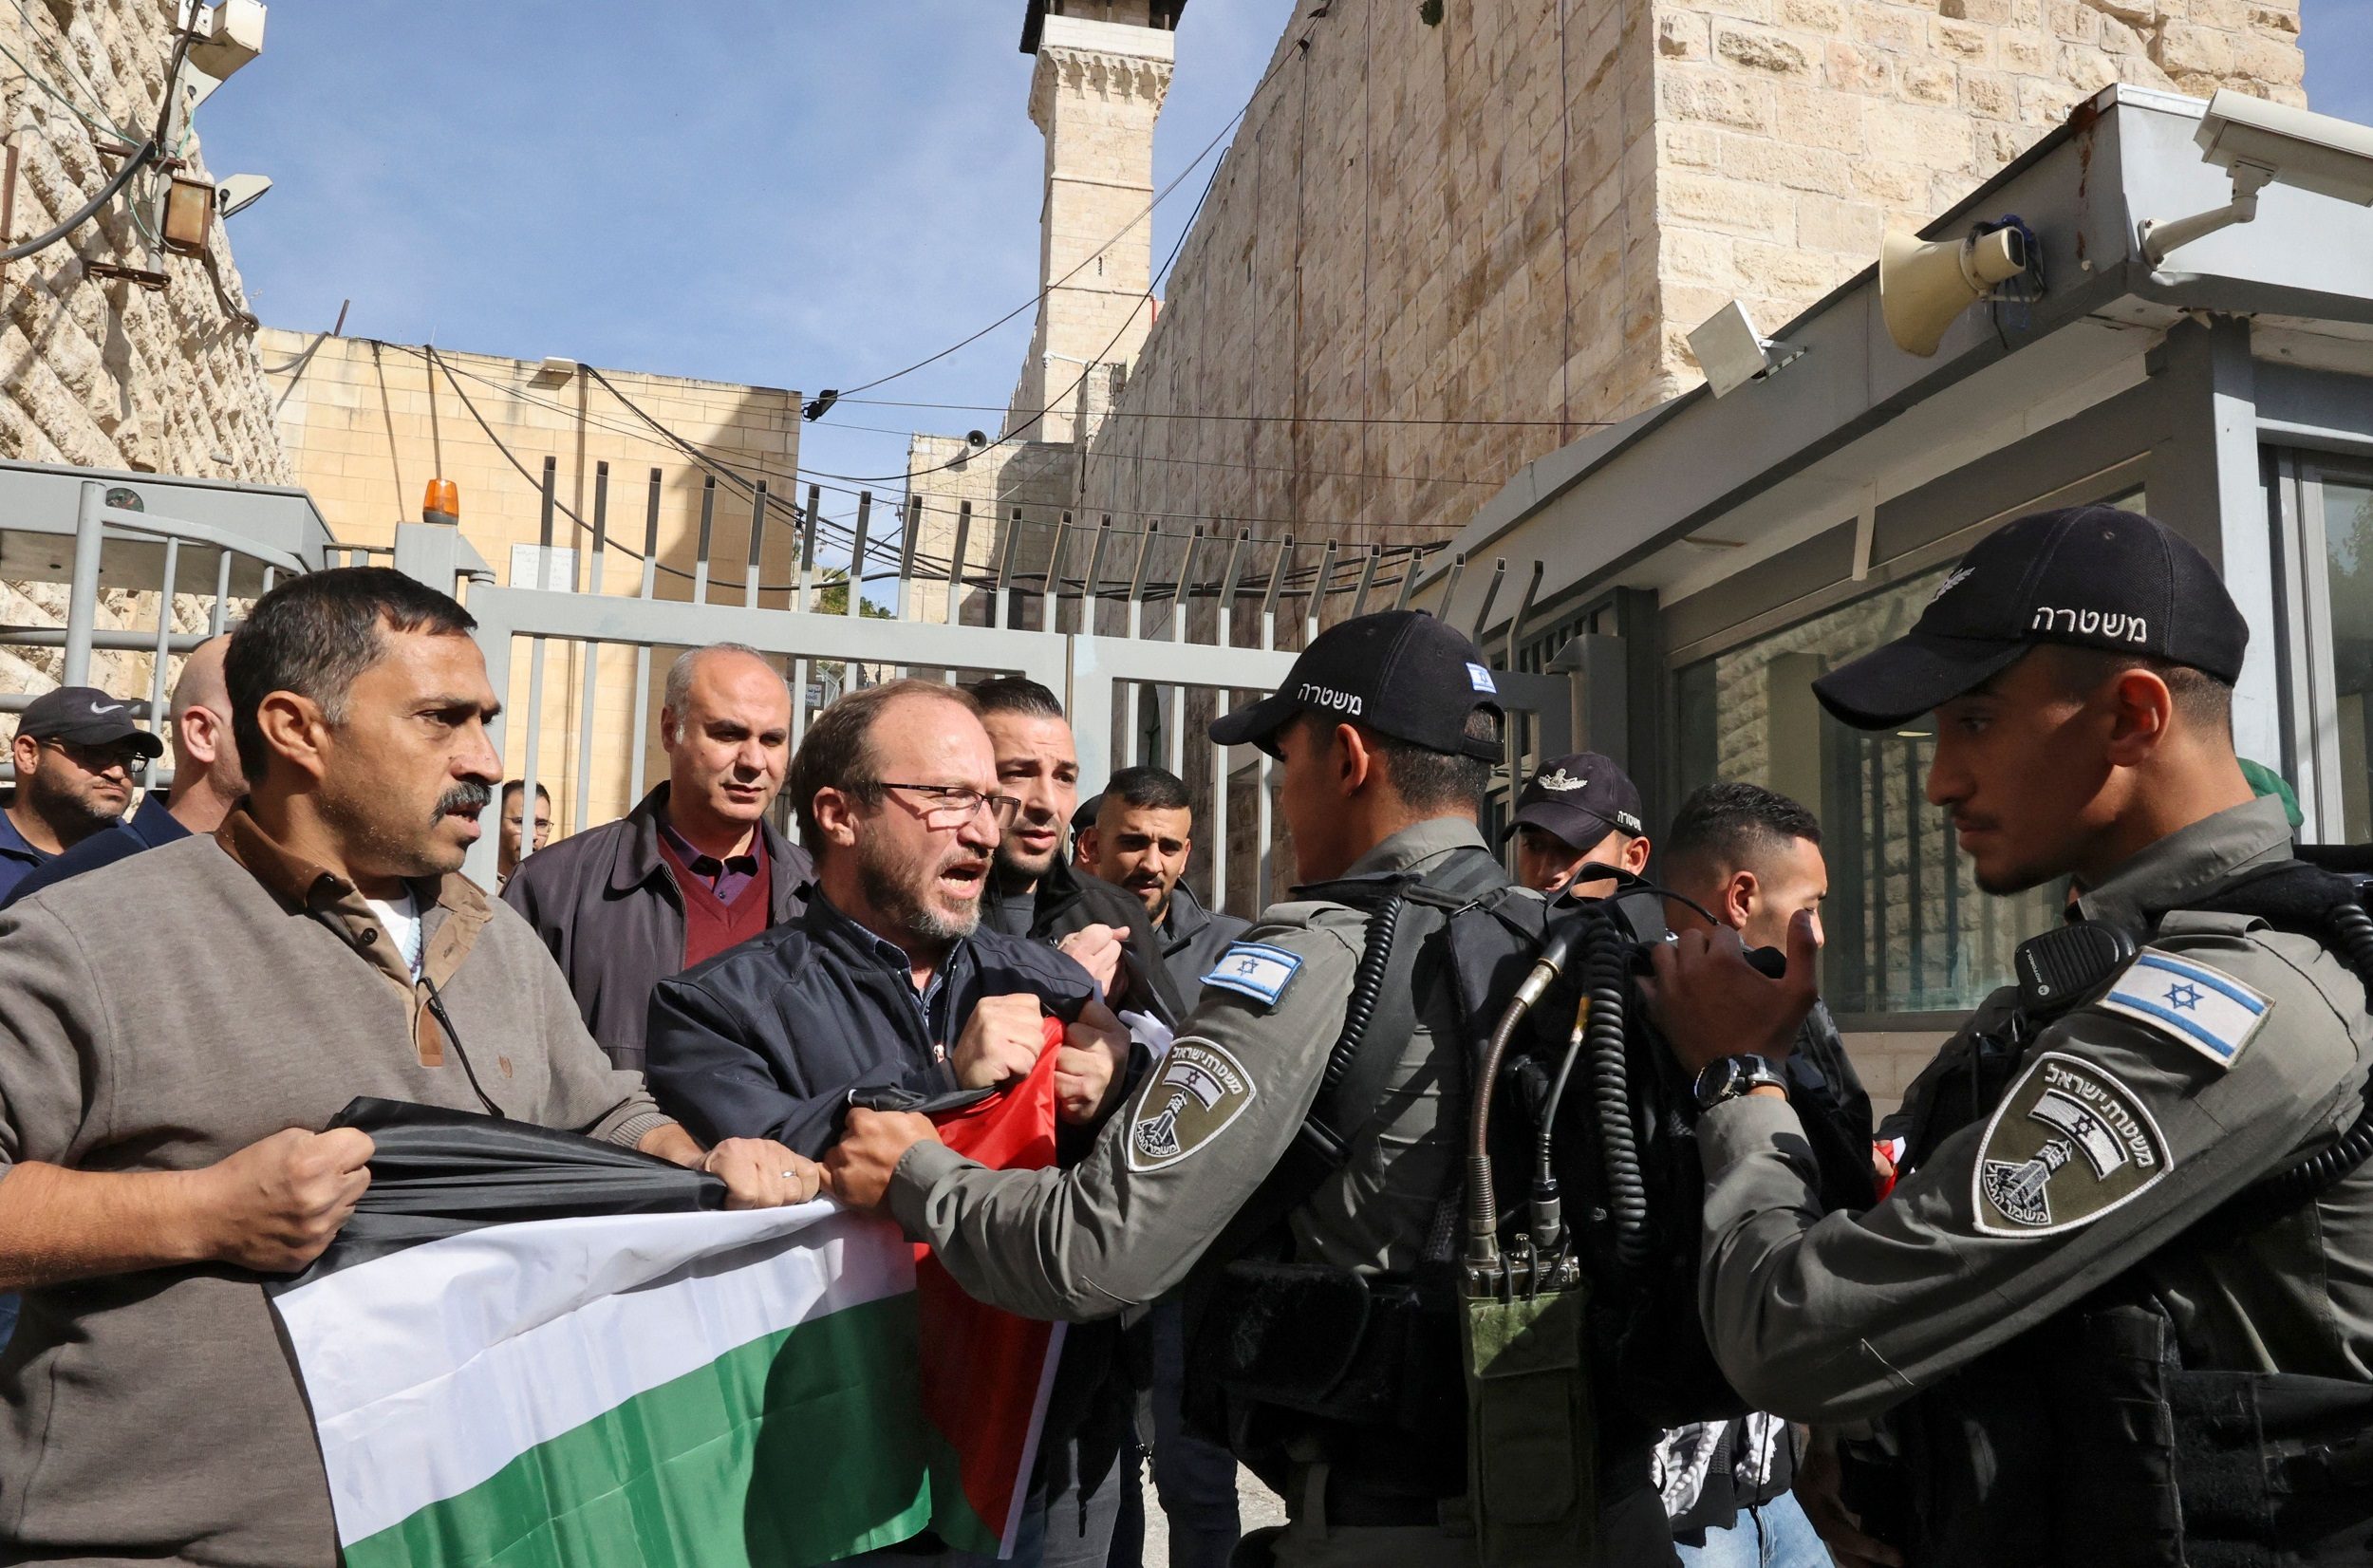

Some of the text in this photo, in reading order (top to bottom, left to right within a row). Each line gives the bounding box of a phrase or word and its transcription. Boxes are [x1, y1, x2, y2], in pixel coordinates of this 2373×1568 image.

[2031, 607, 2147, 643] משטרה
[1297, 682, 1362, 716] משטרה
[2025, 948, 2043, 983] MOTOROLA
[1171, 1045, 1243, 1095] משטרת ישראל
[2044, 1062, 2156, 1169] משטרת ישראל
[2005, 1199, 2047, 1223] משמר
